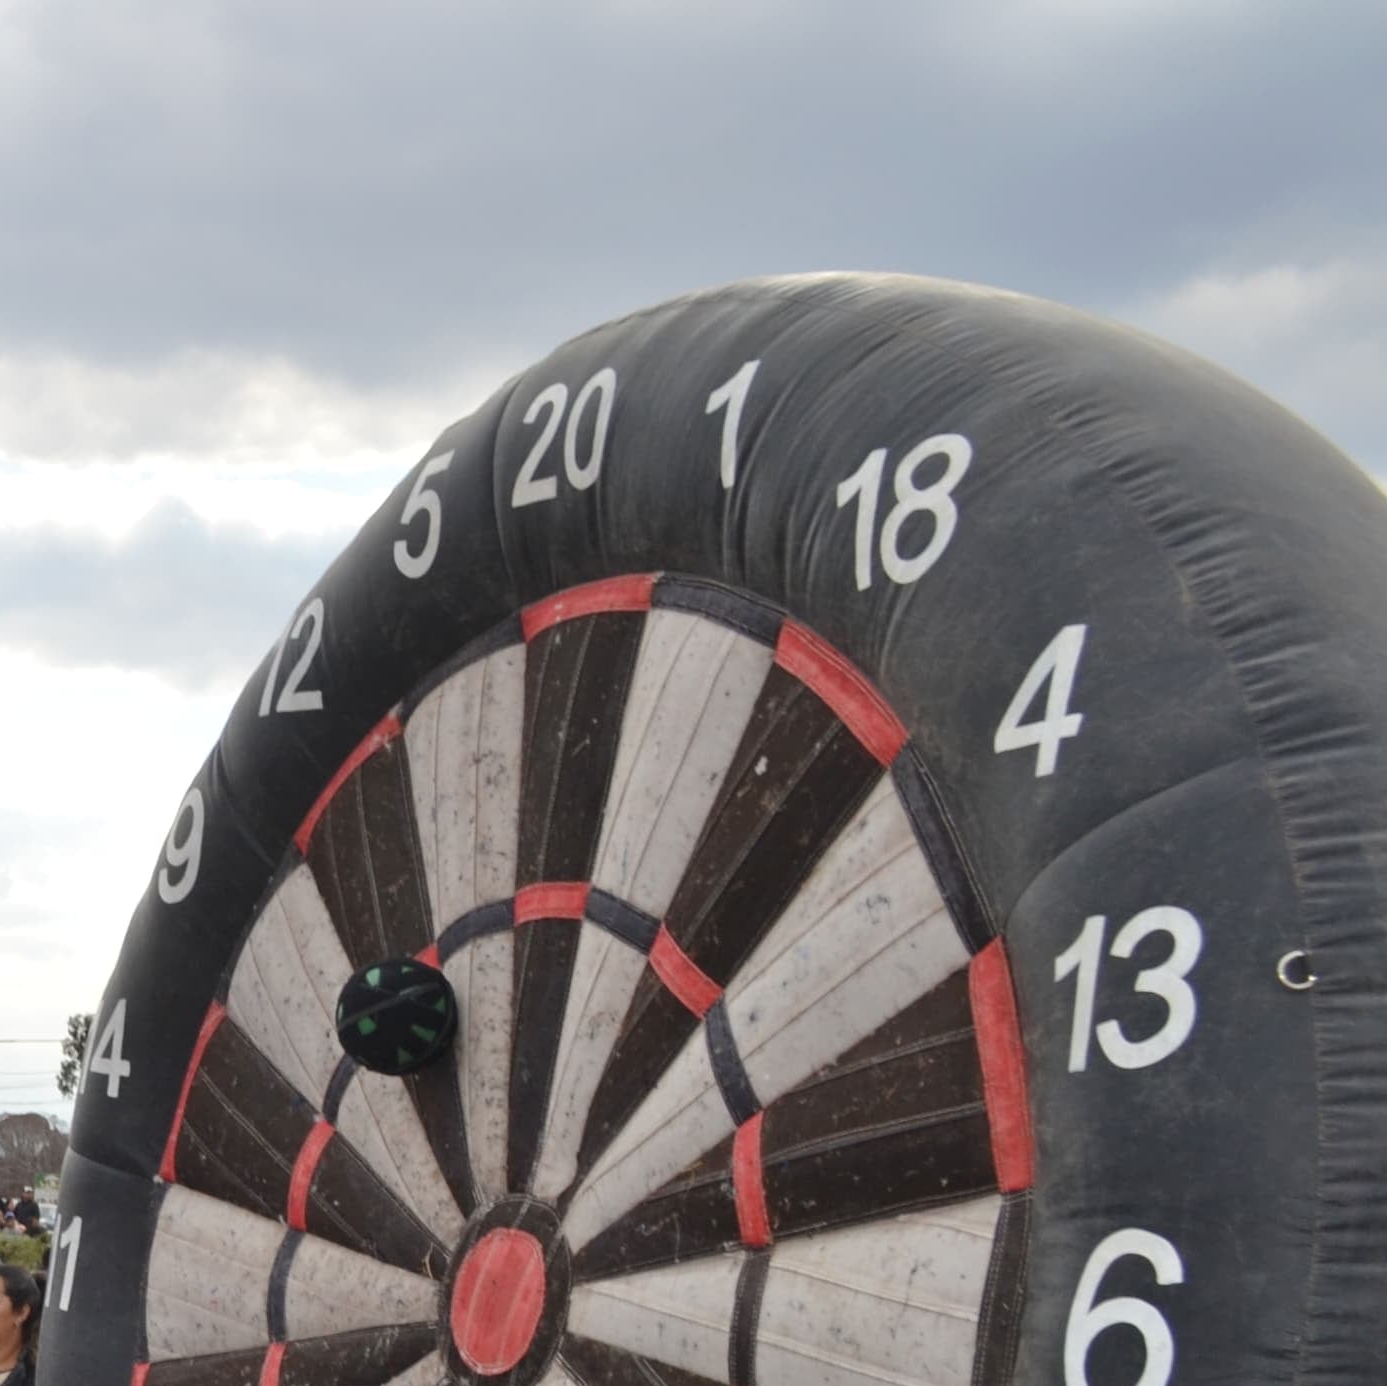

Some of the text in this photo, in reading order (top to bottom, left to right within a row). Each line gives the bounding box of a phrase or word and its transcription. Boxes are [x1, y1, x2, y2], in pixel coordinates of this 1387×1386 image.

[512, 366, 617, 507] 20
[706, 360, 761, 488] 1
[393, 450, 456, 579] 5
[837, 434, 973, 591] 18
[258, 597, 324, 717] 12
[994, 624, 1087, 777] 4
[157, 787, 204, 903] 9
[1054, 906, 1203, 1073] 13
